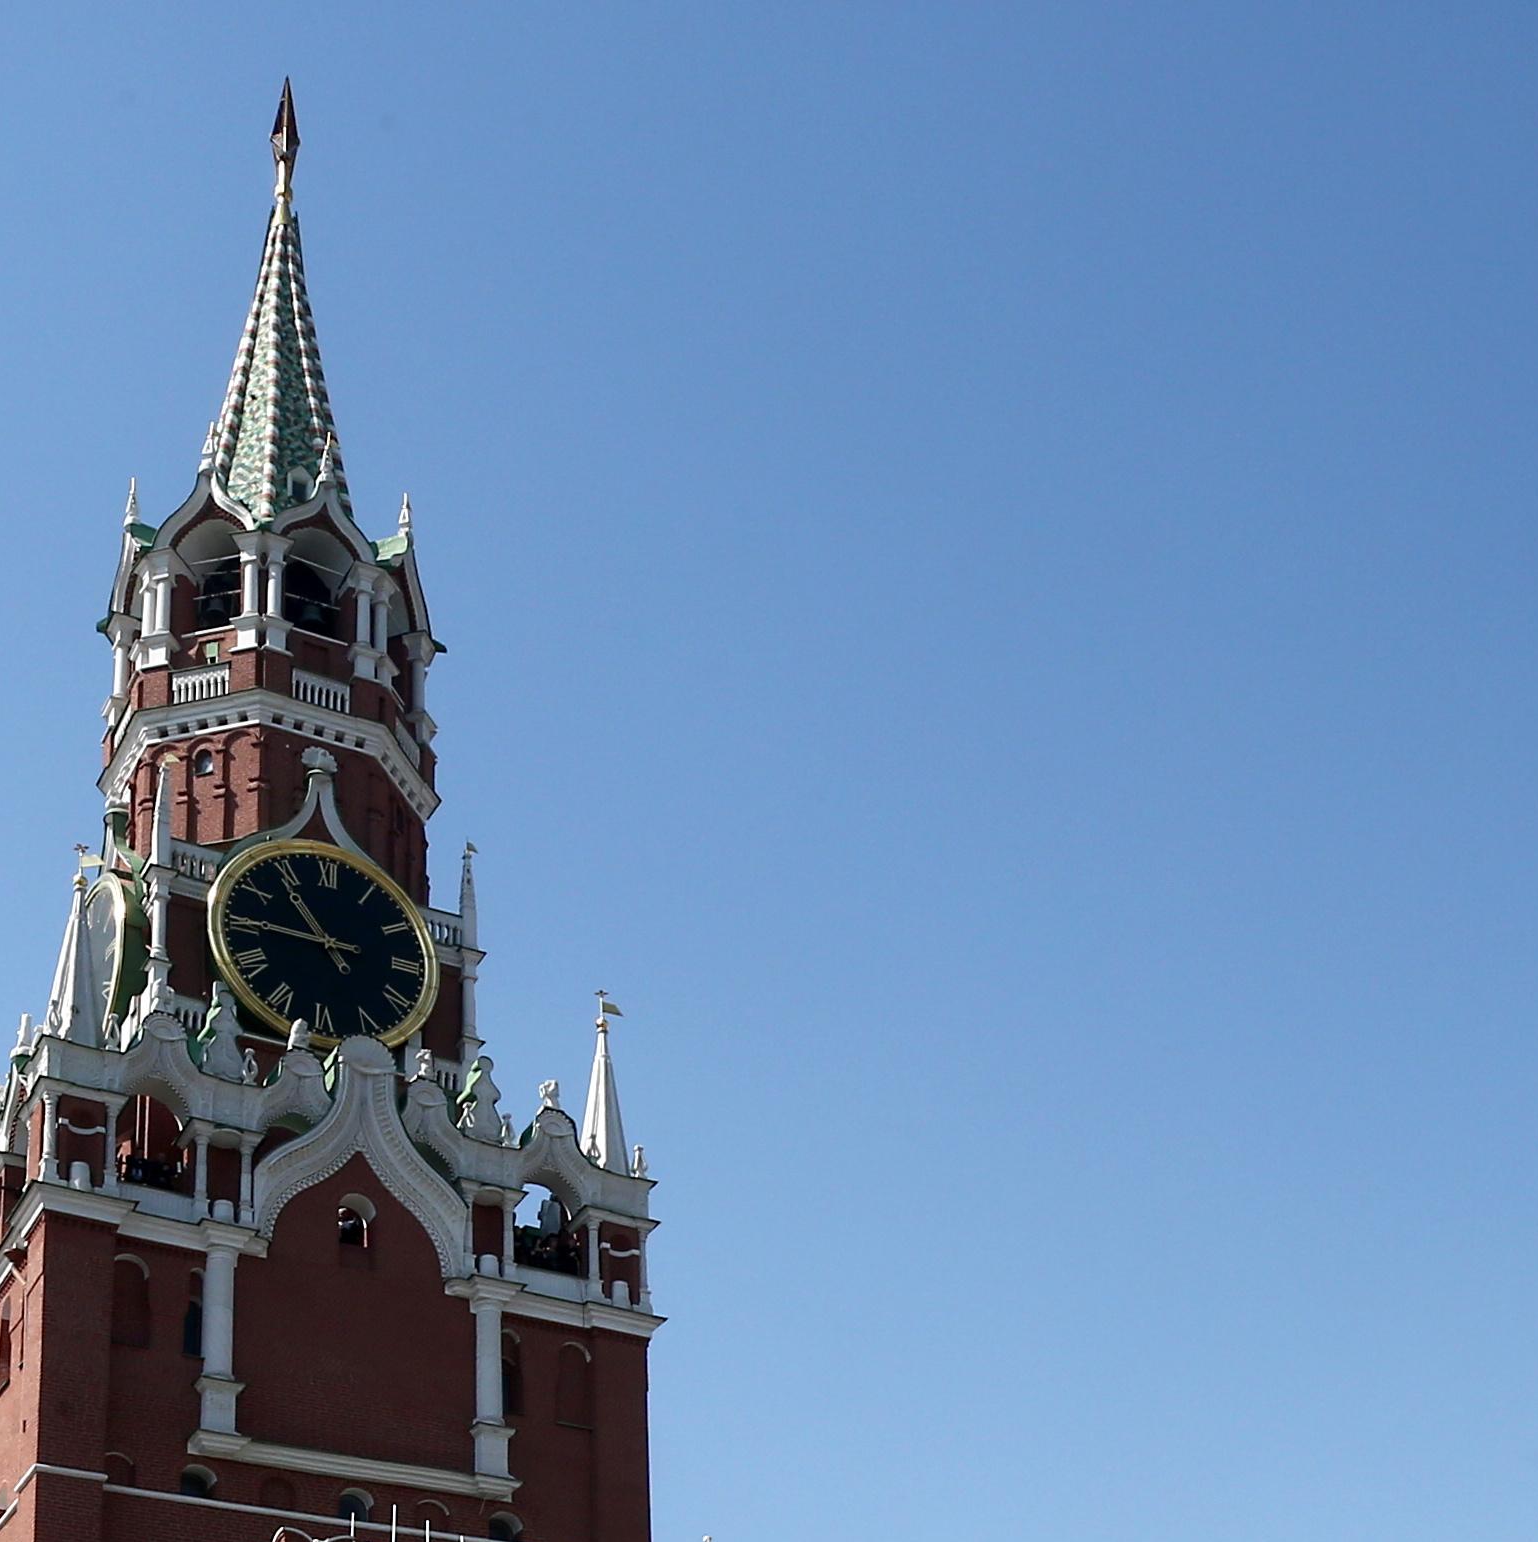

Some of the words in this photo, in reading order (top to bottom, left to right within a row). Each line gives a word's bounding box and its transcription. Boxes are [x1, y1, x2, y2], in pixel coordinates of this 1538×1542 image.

[318, 860, 339, 890] XII
[241, 877, 274, 906] X
[381, 921, 409, 936] II
[235, 947, 270, 979] VIII
[391, 956, 420, 976] III
[266, 981, 295, 1015] VII
[382, 983, 415, 1015] IV
[314, 1002, 335, 1032] VI
[358, 1005, 381, 1033] V
